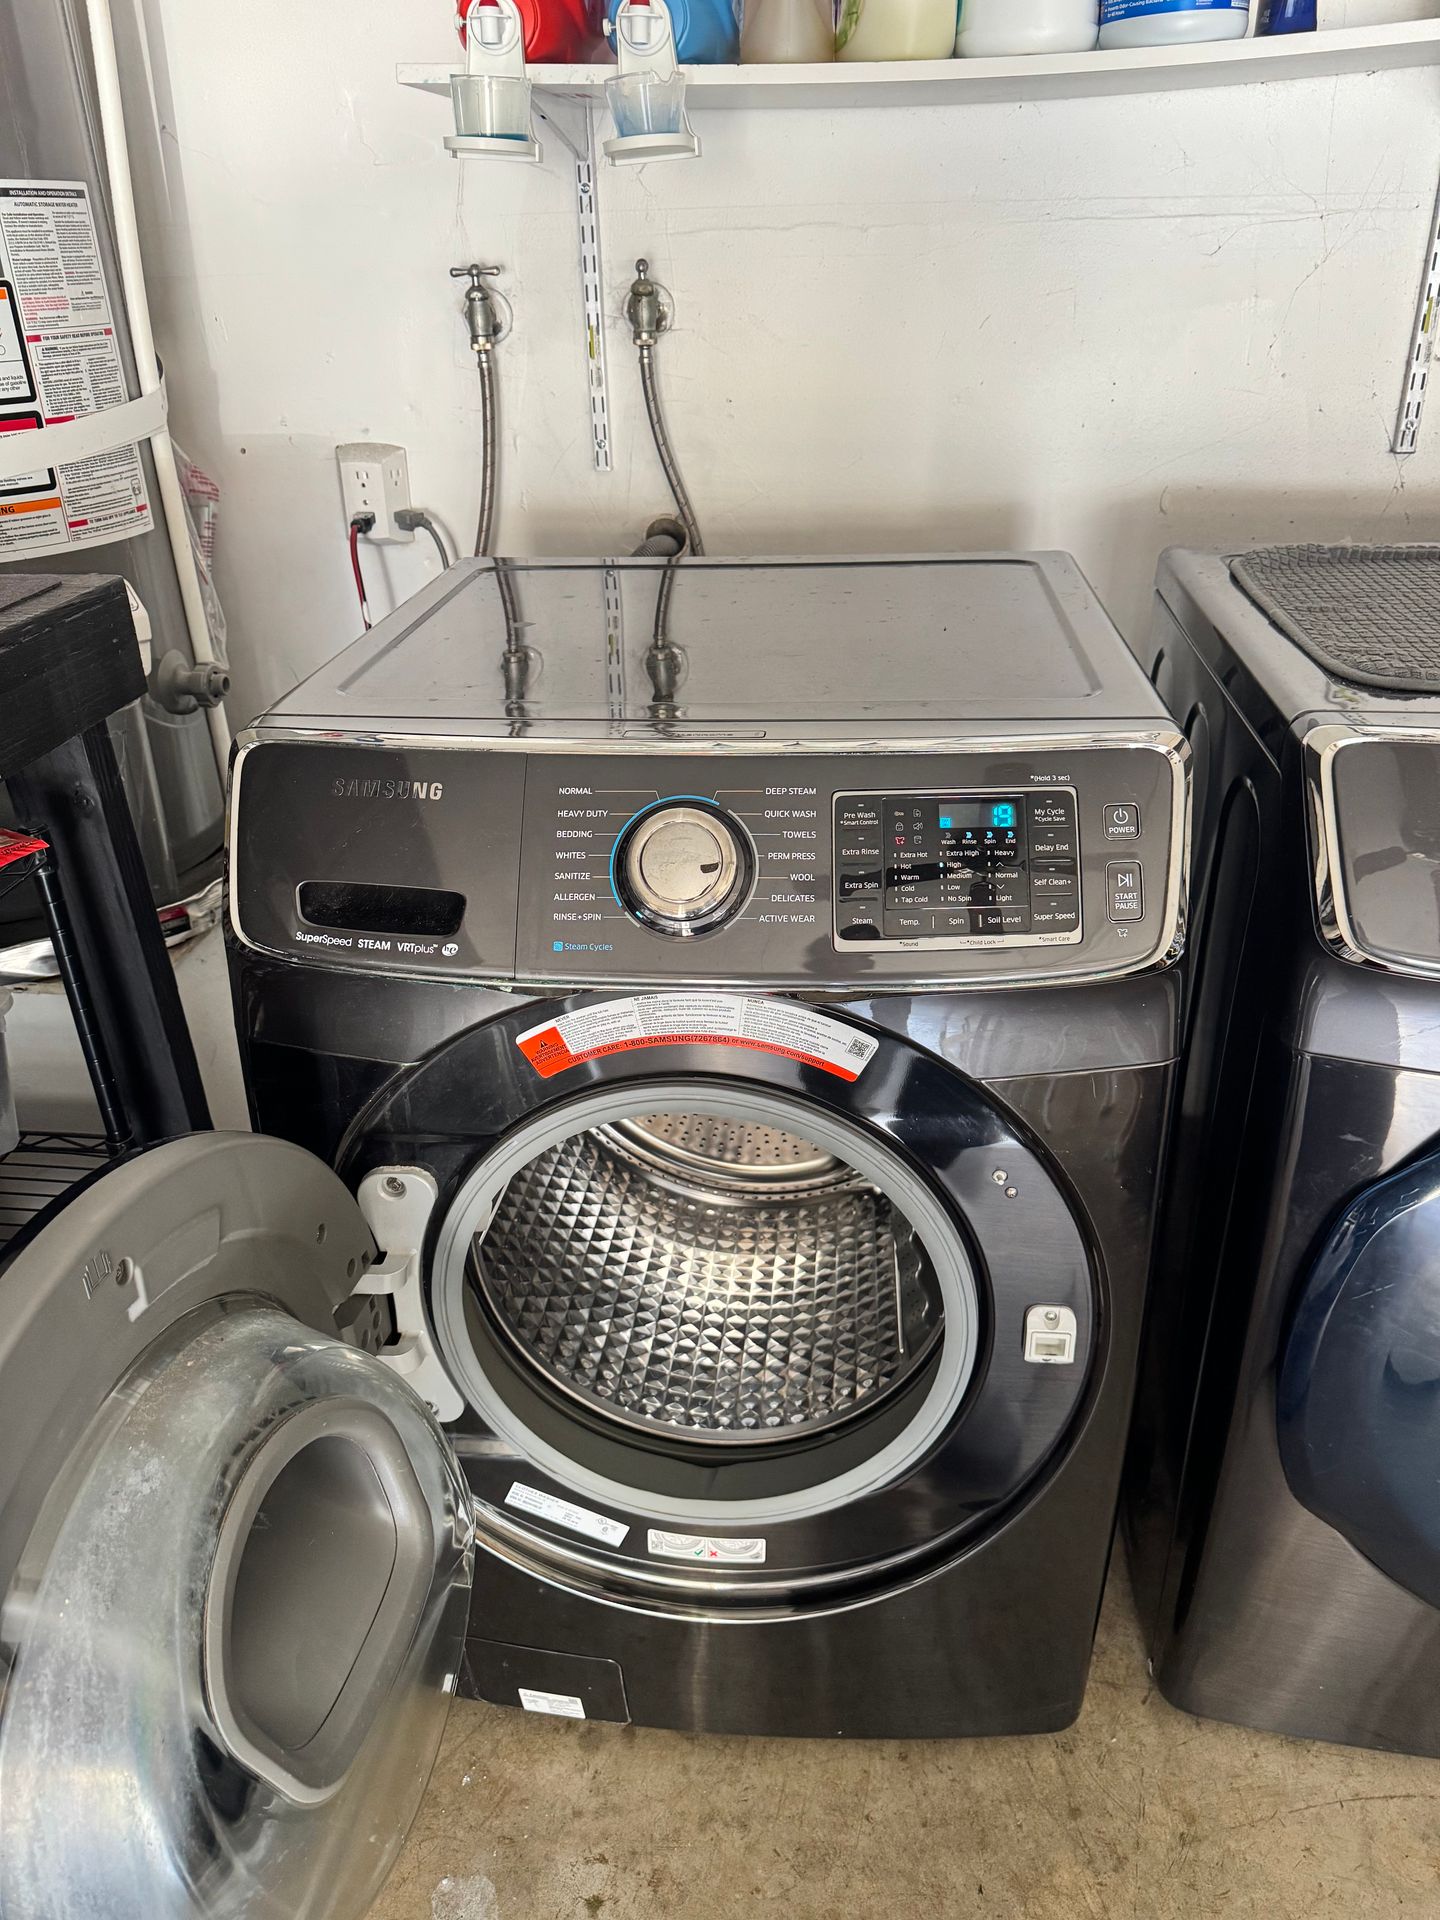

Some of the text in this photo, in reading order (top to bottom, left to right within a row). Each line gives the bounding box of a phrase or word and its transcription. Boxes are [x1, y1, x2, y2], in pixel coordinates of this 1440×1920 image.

[334, 778, 444, 801] SAMSUNG
[559, 787, 592, 795] NORMAL
[765, 787, 816, 795] DEEP STEAM
[557, 810, 608, 818] HEAVY DUTY
[764, 810, 817, 819] QUICK WASH
[1035, 808, 1065, 816] My Cycle
[556, 830, 593, 838] BEDDING
[1108, 826, 1135, 834] POWER
[782, 831, 816, 839] TOWELS
[1035, 844, 1054, 852] Delay
[767, 852, 816, 860] PERM PRESS
[554, 872, 591, 880] SANITIZE
[864, 881, 879, 889] Spin
[553, 893, 596, 901] ALLERGEN
[771, 894, 815, 902] DELICATES
[759, 915, 815, 923] ACTIVE WEAR
[987, 916, 1001, 924] Soil
[1034, 912, 1076, 921] Super Speed
[948, 917, 965, 925] Spin
[295, 931, 352, 947] SuperSpeed
[358, 939, 391, 950] STEAM
[589, 943, 613, 951] Cycles
[567, 1048, 602, 1064] CUSTOMER
[602, 1044, 622, 1053] CARE:
